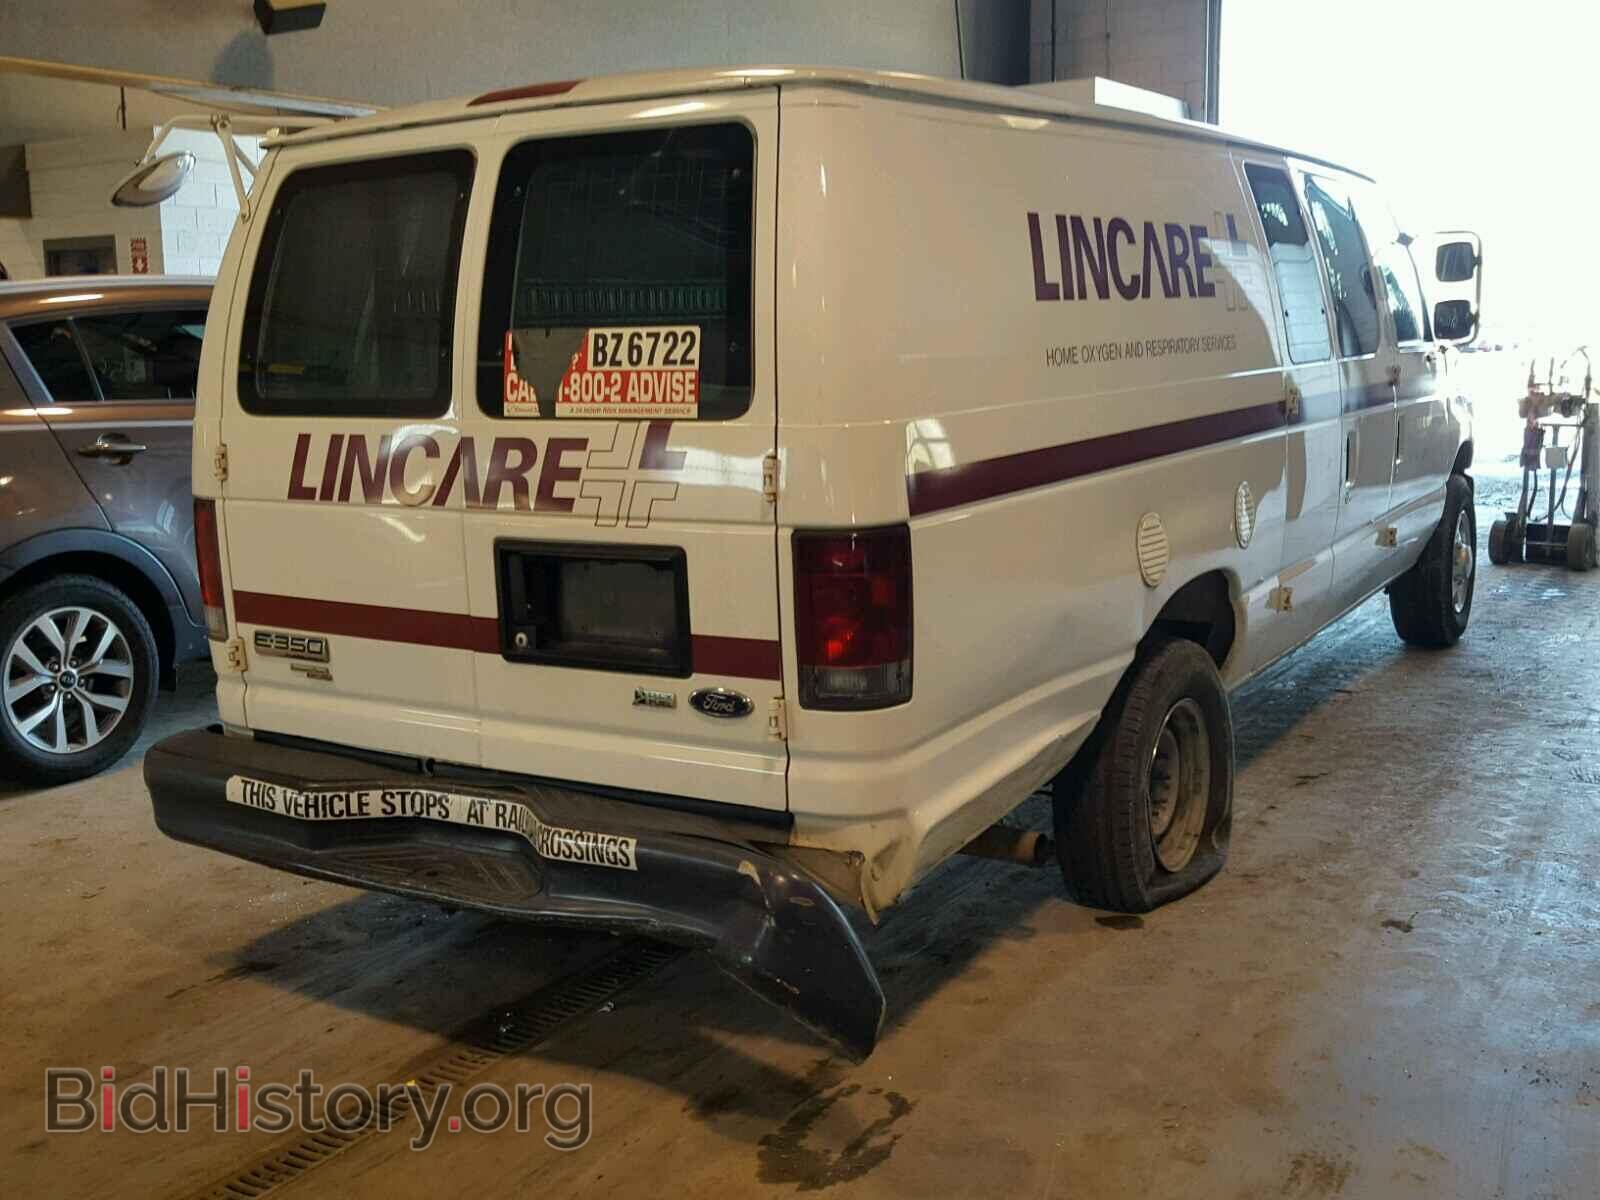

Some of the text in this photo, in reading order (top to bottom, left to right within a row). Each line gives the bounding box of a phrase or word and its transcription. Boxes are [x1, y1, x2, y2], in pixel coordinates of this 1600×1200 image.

[1027, 211, 1216, 301] LINCARE
[1046, 334, 1237, 367] HOME OXYGEN AND RESPIRATORY SERVICES
[626, 371, 696, 403] ADVISE
[287, 433, 590, 512] LINCARE
[703, 694, 735, 712] Ford
[241, 779, 276, 810] THIS
[282, 789, 370, 818] VEHICLE
[381, 790, 450, 818] STOPS
[466, 798, 490, 826] AT
[537, 825, 632, 868] CROSSINGS
